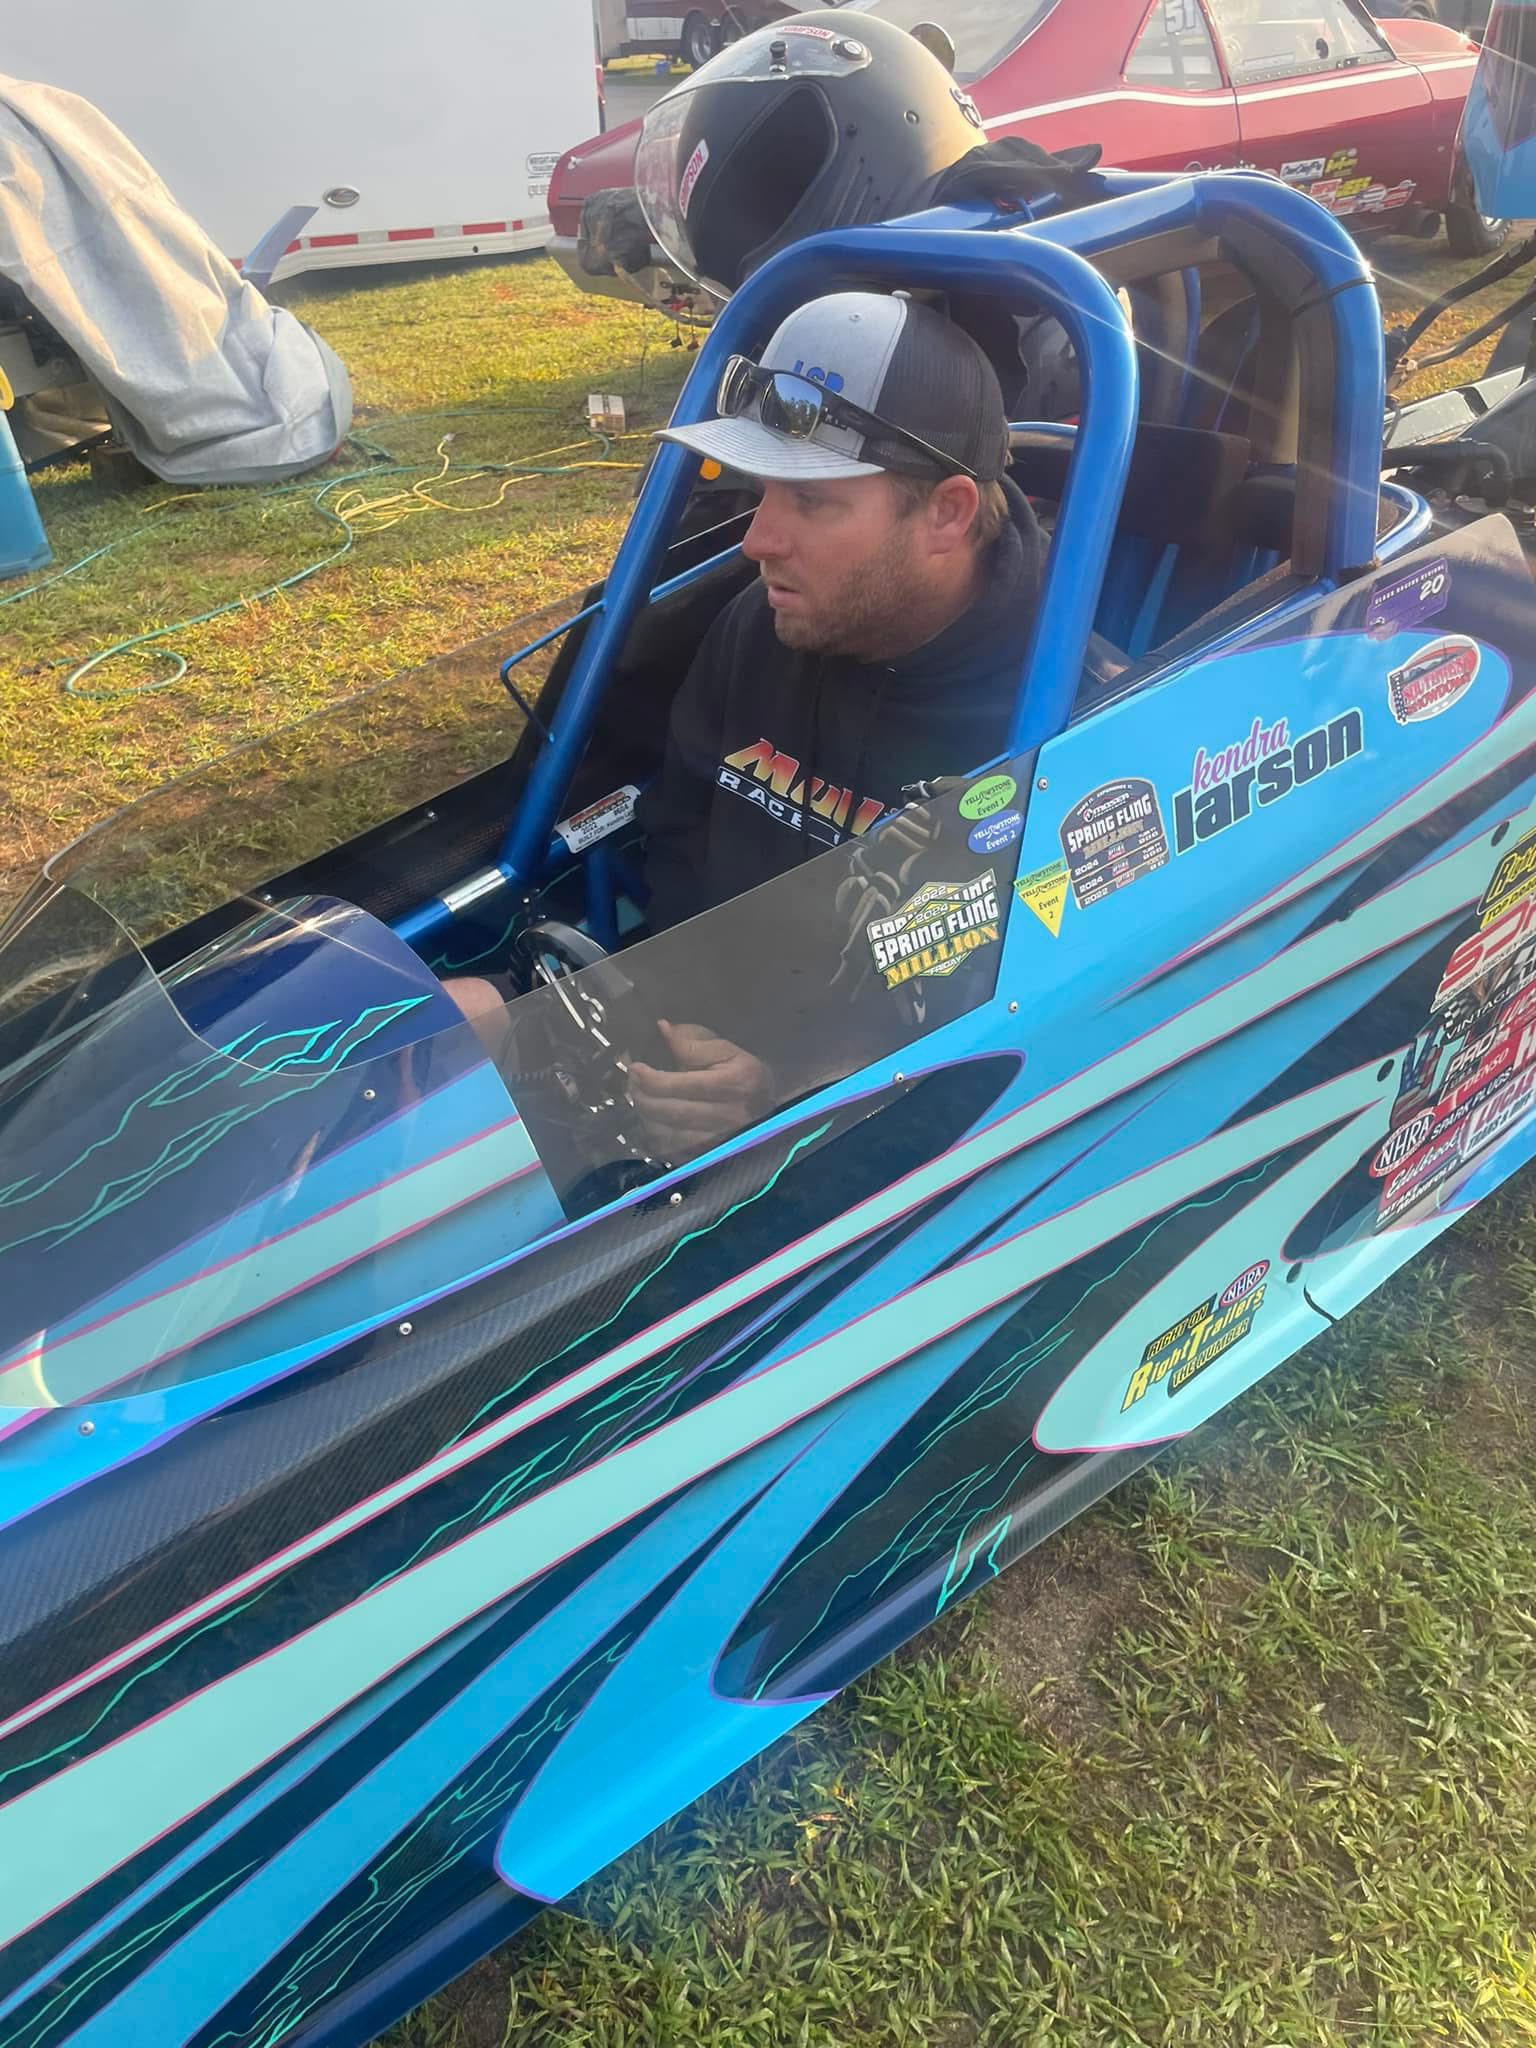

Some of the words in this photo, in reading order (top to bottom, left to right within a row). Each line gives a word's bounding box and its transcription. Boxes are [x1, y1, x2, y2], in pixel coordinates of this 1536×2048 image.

[1419, 574, 1445, 600] 20
[1194, 718, 1289, 796] kendra
[1174, 710, 1362, 854] larson
[977, 801, 999, 817] Event
[1000, 796, 1006, 805] 1
[1067, 817, 1115, 853] SPRING
[1117, 793, 1153, 827] FLING
[985, 834, 1009, 850] Event
[1010, 829, 1017, 839] 2
[1074, 858, 1099, 876] 2024
[912, 885, 948, 907] 2022
[1079, 875, 1104, 893] 2024
[915, 903, 949, 923] 2024
[1038, 895, 1059, 911] Event
[1049, 911, 1054, 919] 2
[873, 920, 945, 970] SPRING
[946, 891, 999, 934] FLING
[883, 922, 1000, 990] MILLION
[929, 955, 962, 976] FRIDAY
[1379, 1115, 1431, 1168] NHRA
[1227, 1266, 1266, 1301] NHRA
[1147, 1317, 1188, 1361] RIGHT
[1187, 1301, 1210, 1329] ON
[1172, 1355, 1197, 1389] THE
[1195, 1316, 1250, 1367] NUMBER
